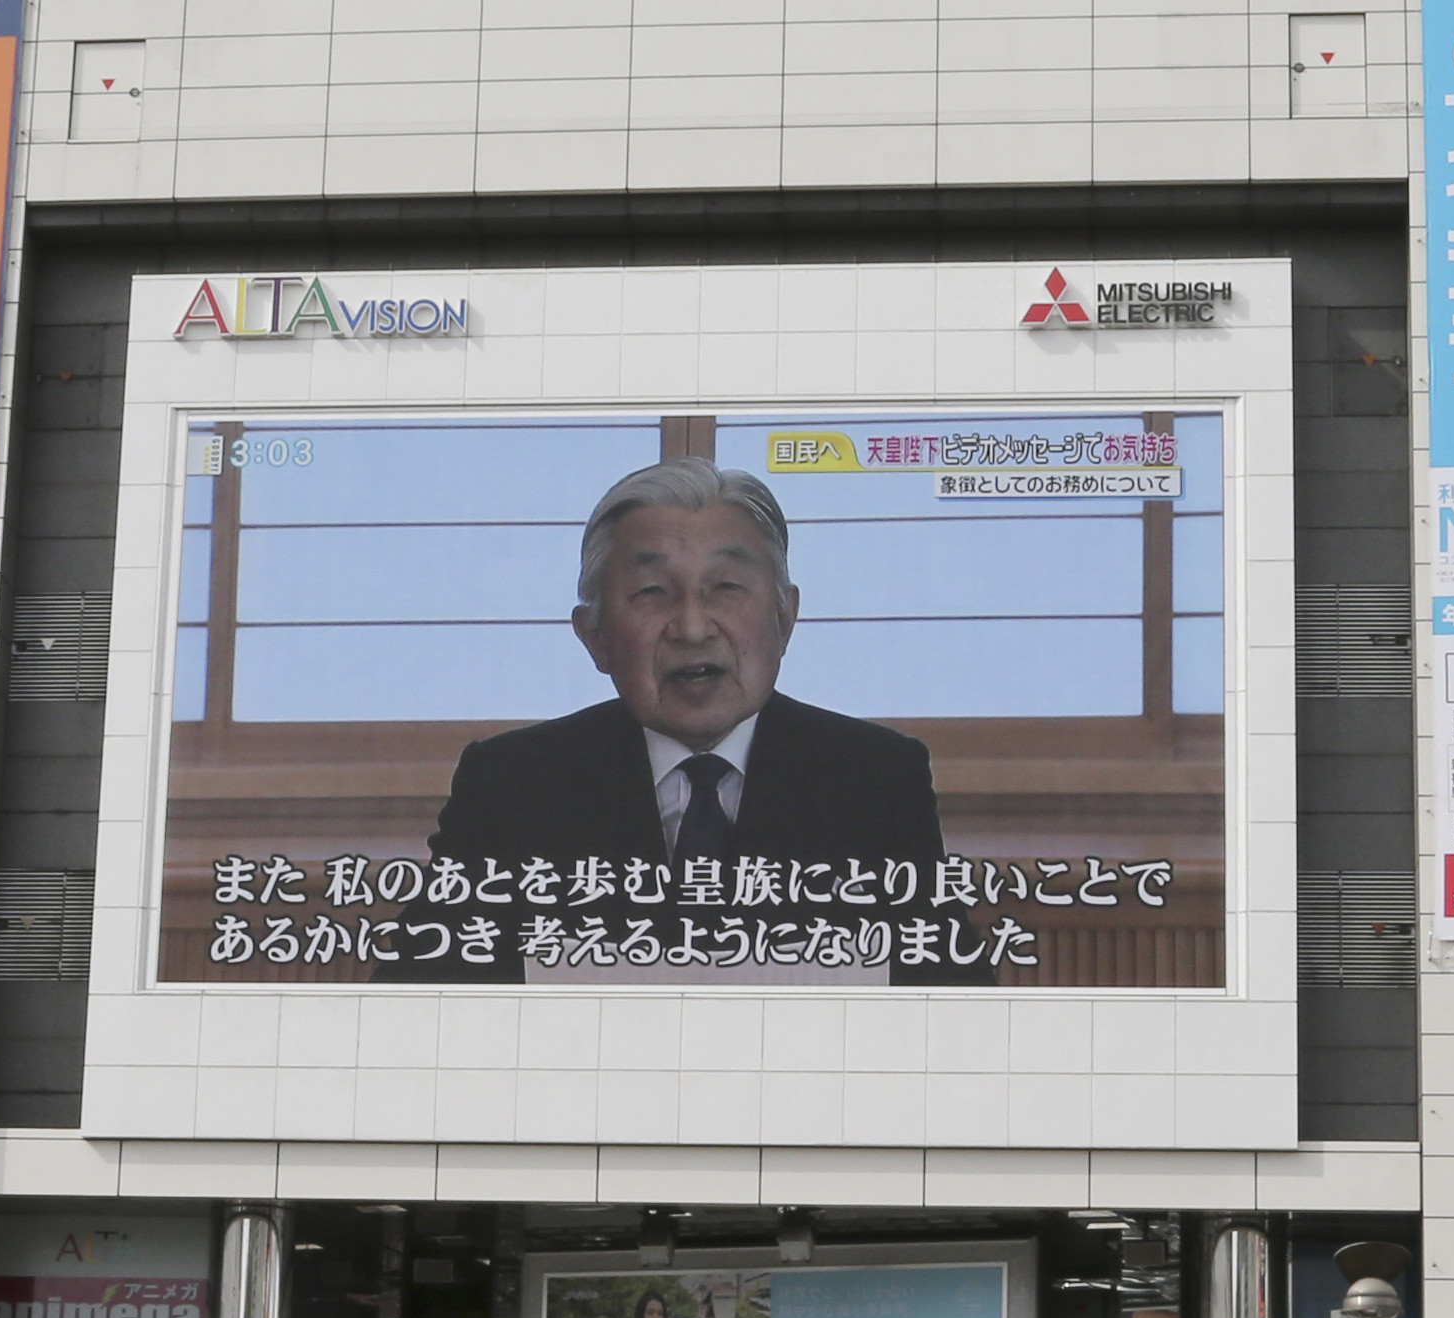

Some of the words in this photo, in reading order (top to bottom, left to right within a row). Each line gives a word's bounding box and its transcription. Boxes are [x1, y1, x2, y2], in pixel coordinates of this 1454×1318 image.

[1097, 282, 1232, 302] MITSUBISHI
[173, 277, 343, 338] ALTA
[1097, 303, 1215, 324] ELECTRIC
[230, 438, 314, 467] 3:03
[775, 440, 840, 463] 国民へ
[867, 433, 1175, 464] 天皇陛下ビデオメッセージでお気持ち
[941, 475, 1170, 494] 象徴としてのお務めについて
[213, 856, 305, 904] また
[210, 915, 502, 965] あるかにつき
[517, 915, 1038, 966] 考えるようになりました
[125, 1284, 199, 1299] アニメガ
